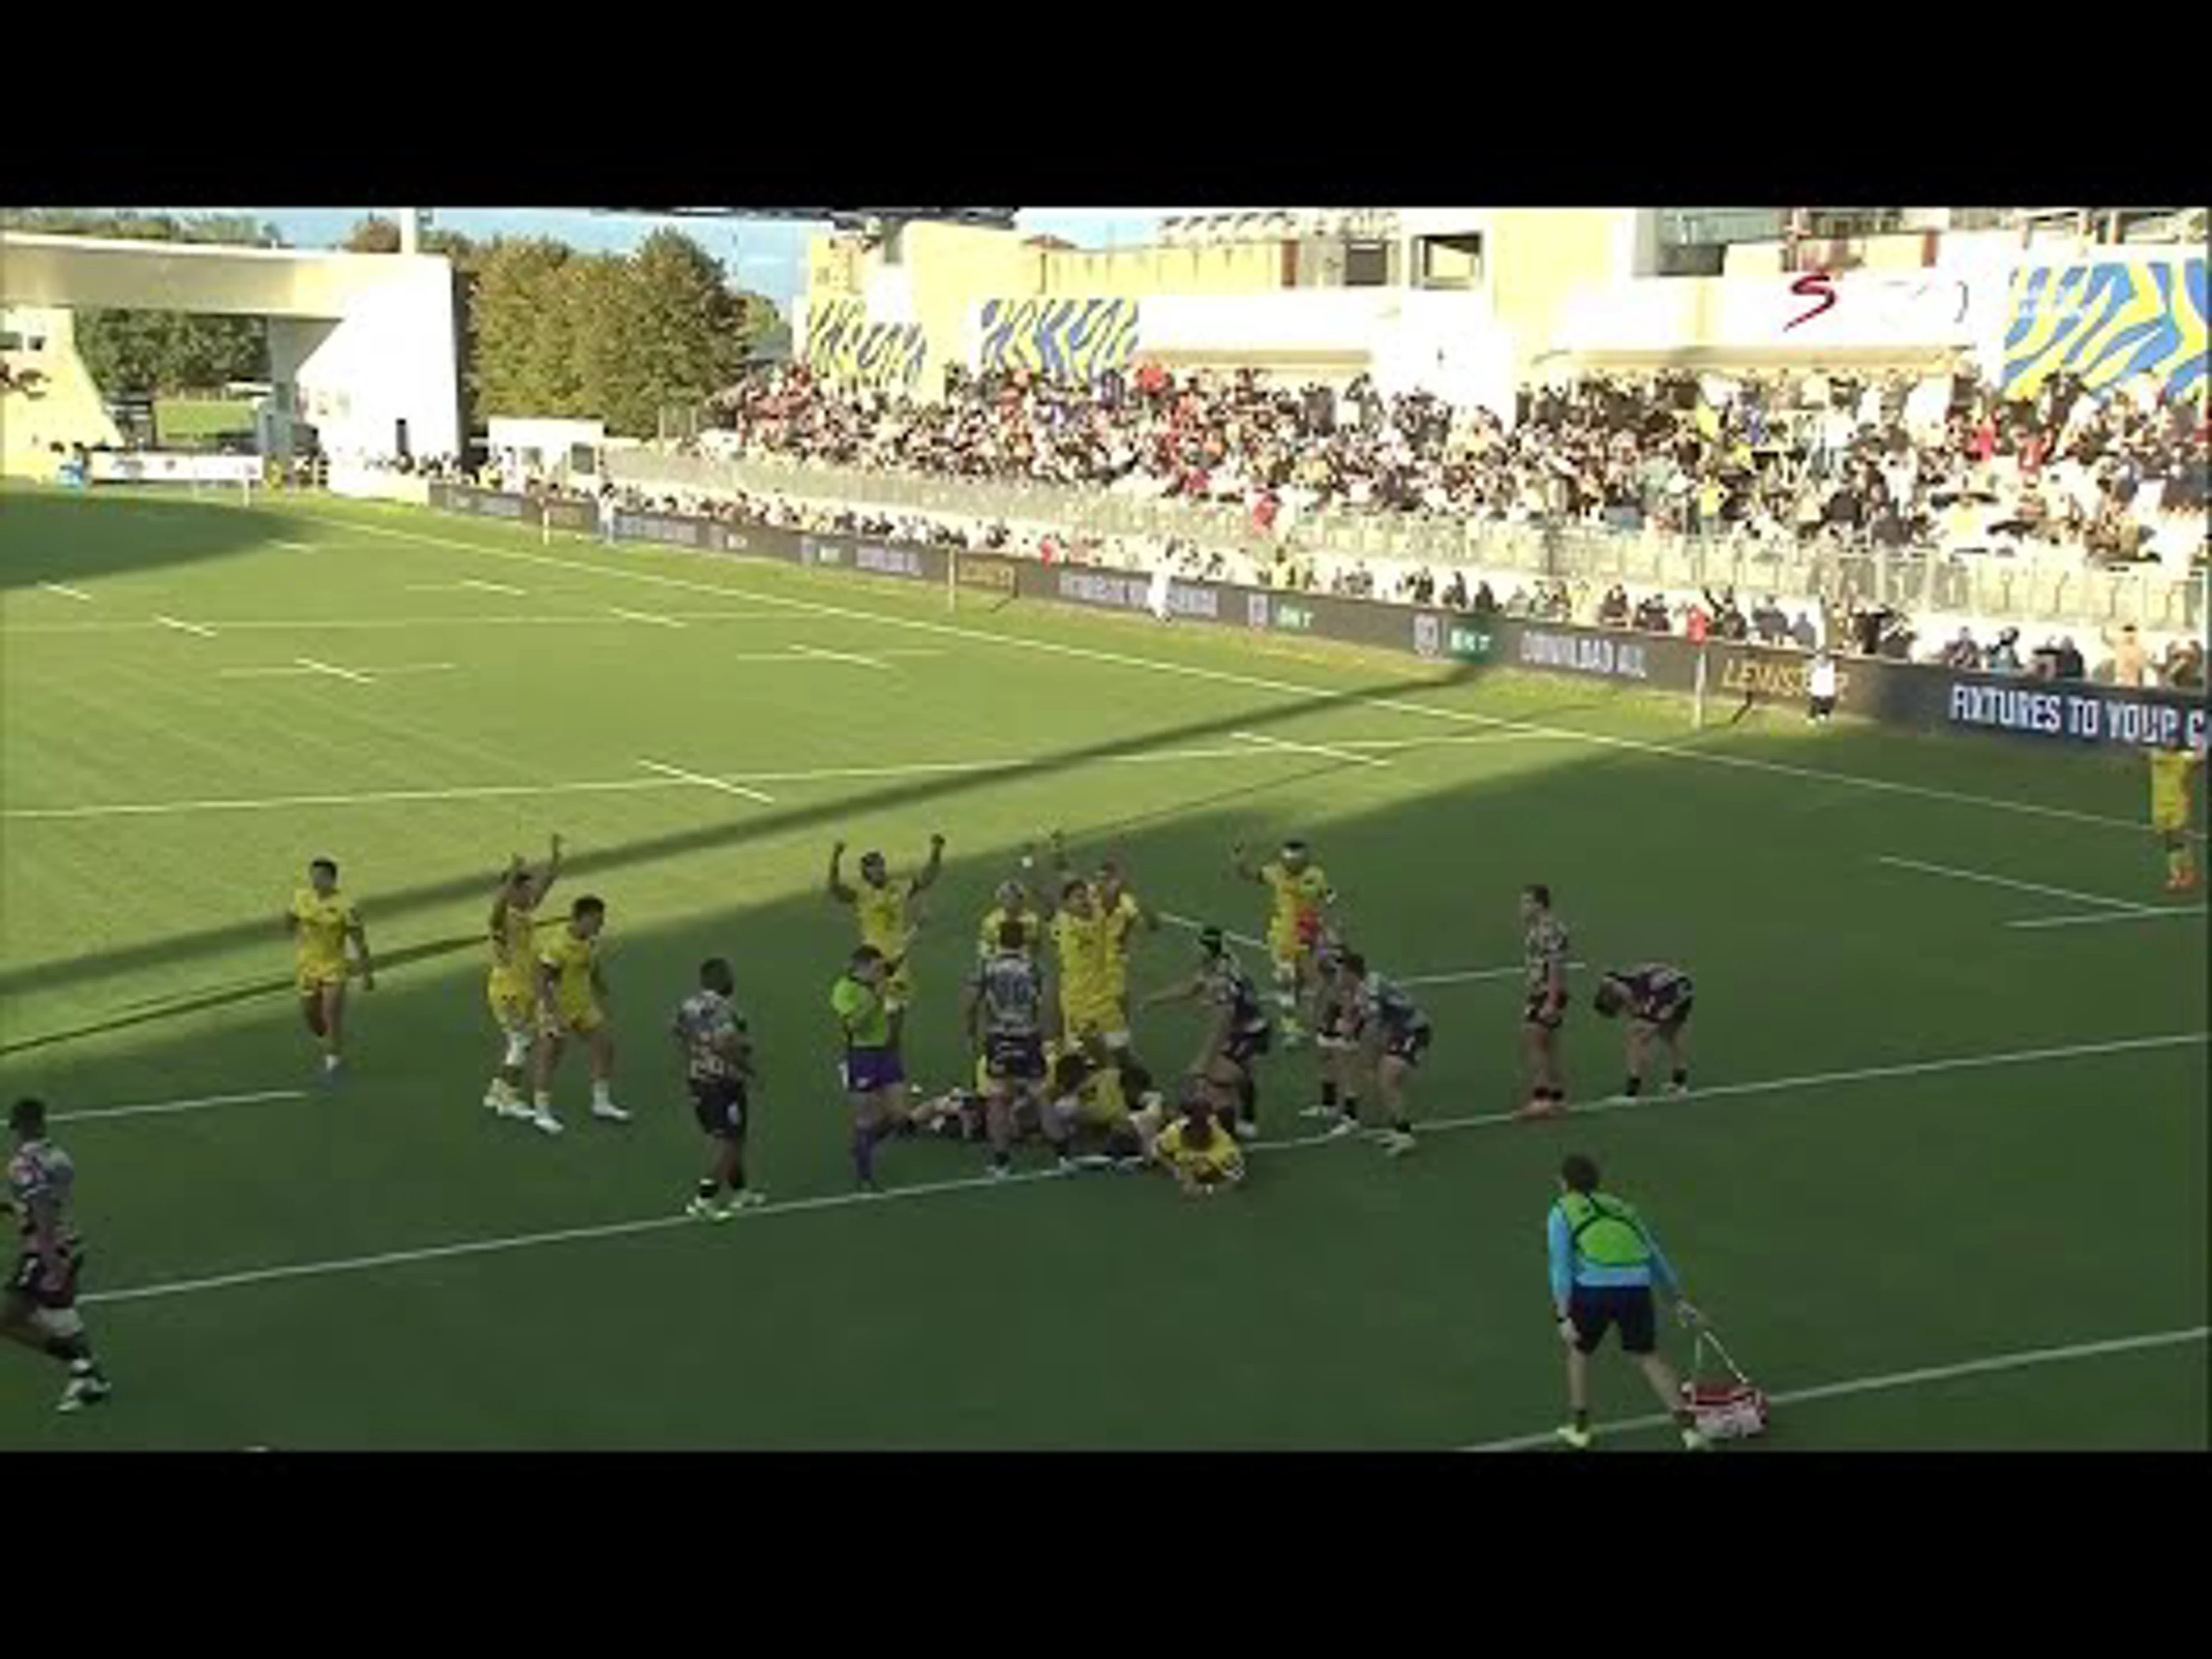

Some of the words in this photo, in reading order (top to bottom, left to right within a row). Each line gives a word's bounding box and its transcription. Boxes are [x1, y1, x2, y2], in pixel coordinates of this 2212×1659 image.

[1949, 684, 2061, 734] FIXTURES
[2067, 695, 2100, 736] TO
[2106, 700, 2180, 743] YOUR
